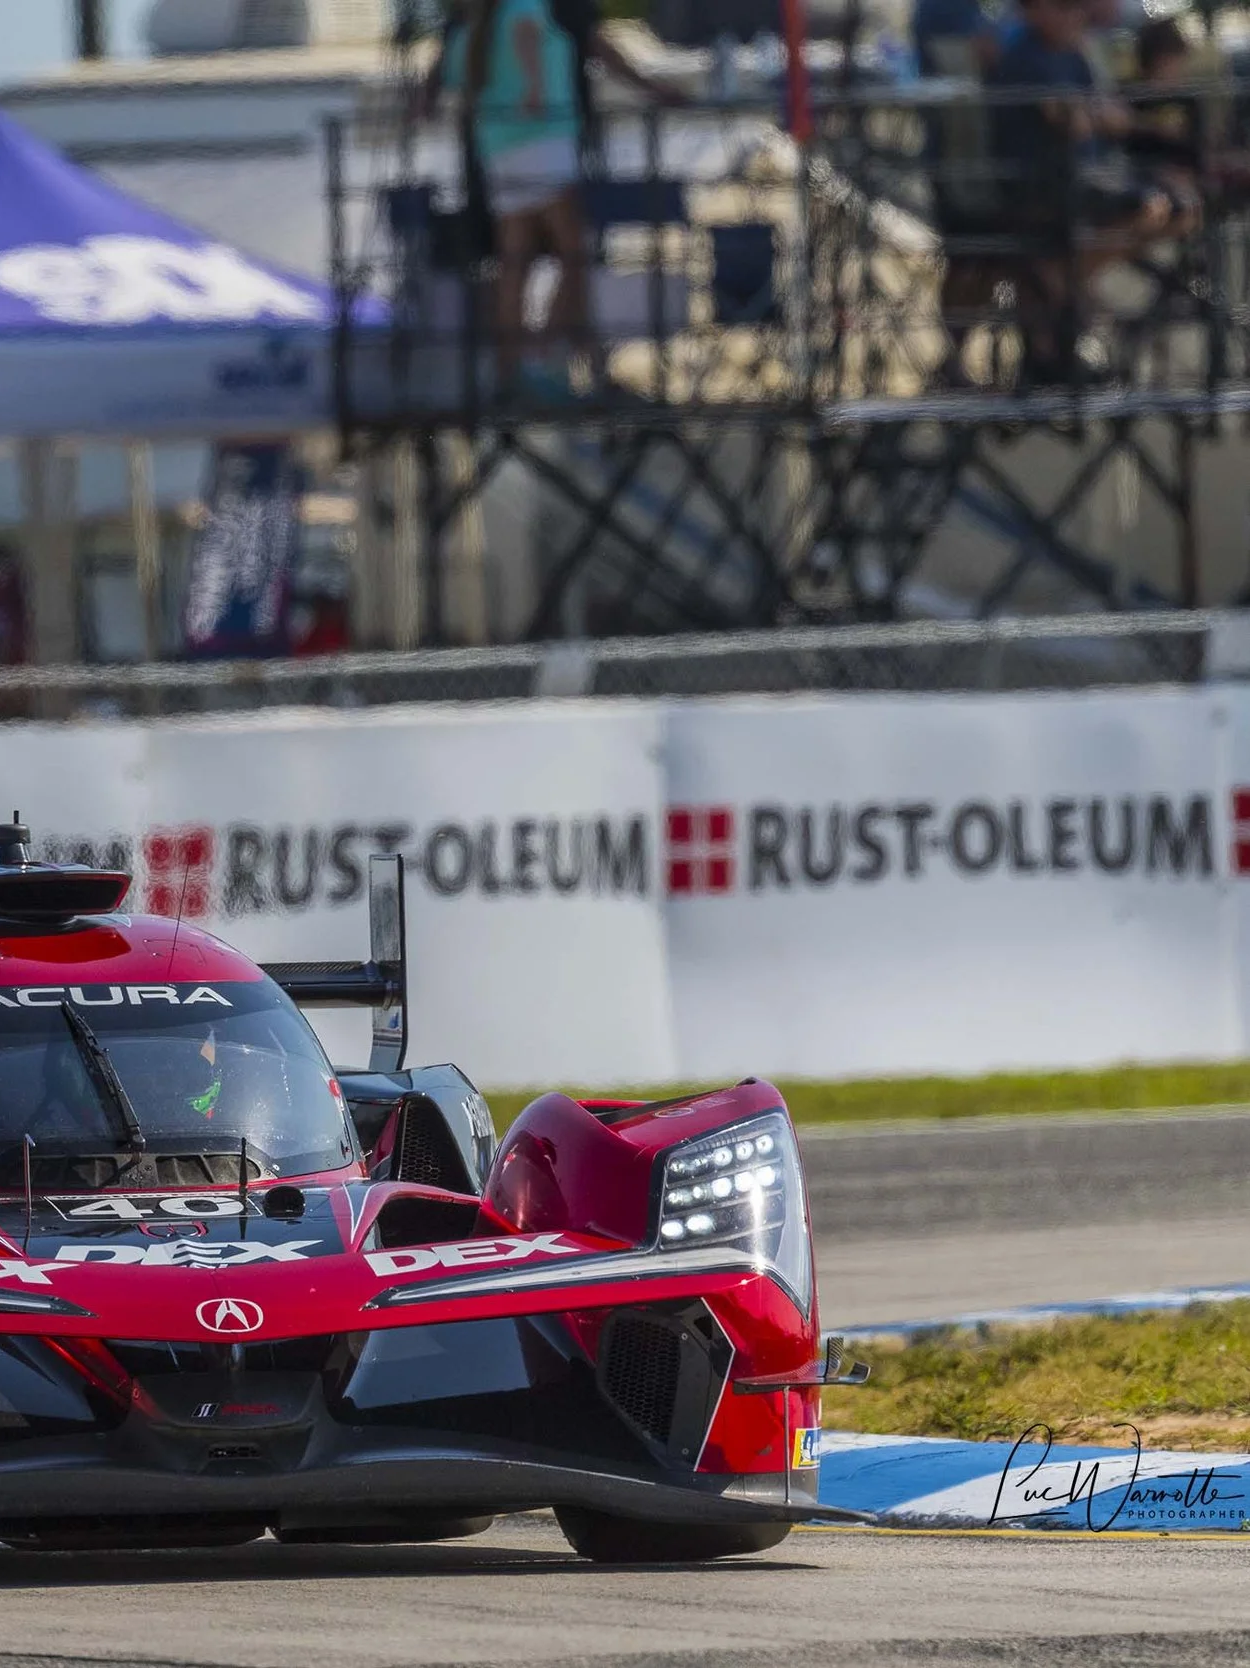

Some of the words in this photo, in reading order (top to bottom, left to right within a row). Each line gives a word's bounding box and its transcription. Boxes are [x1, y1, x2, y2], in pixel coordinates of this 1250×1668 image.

[749, 797, 1216, 889] RUST-OLEUM
[68, 1195, 245, 1219] 40
[54, 1239, 324, 1266] DEX
[363, 1233, 581, 1277] DEX
